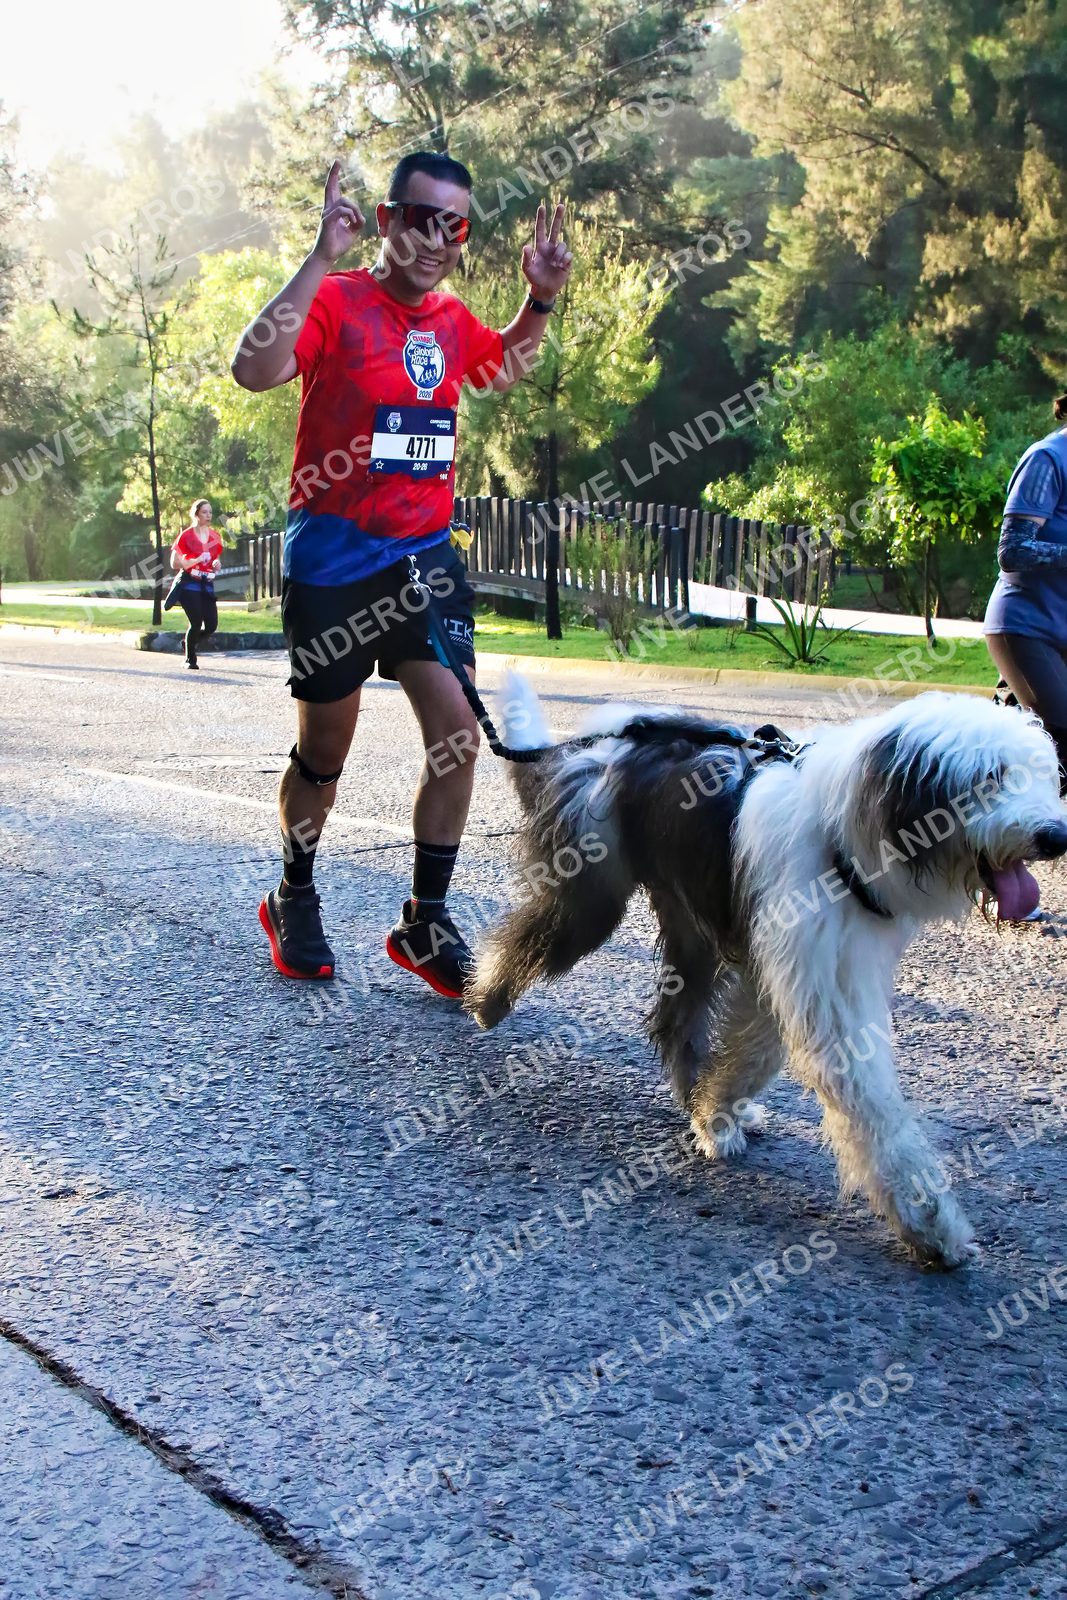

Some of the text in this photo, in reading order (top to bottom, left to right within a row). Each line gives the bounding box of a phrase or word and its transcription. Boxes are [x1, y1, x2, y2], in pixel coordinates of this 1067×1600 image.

[414, 346, 434, 358] Global
[411, 355, 429, 366] Race
[418, 389, 433, 399] 2026
[406, 436, 436, 459] 4771
